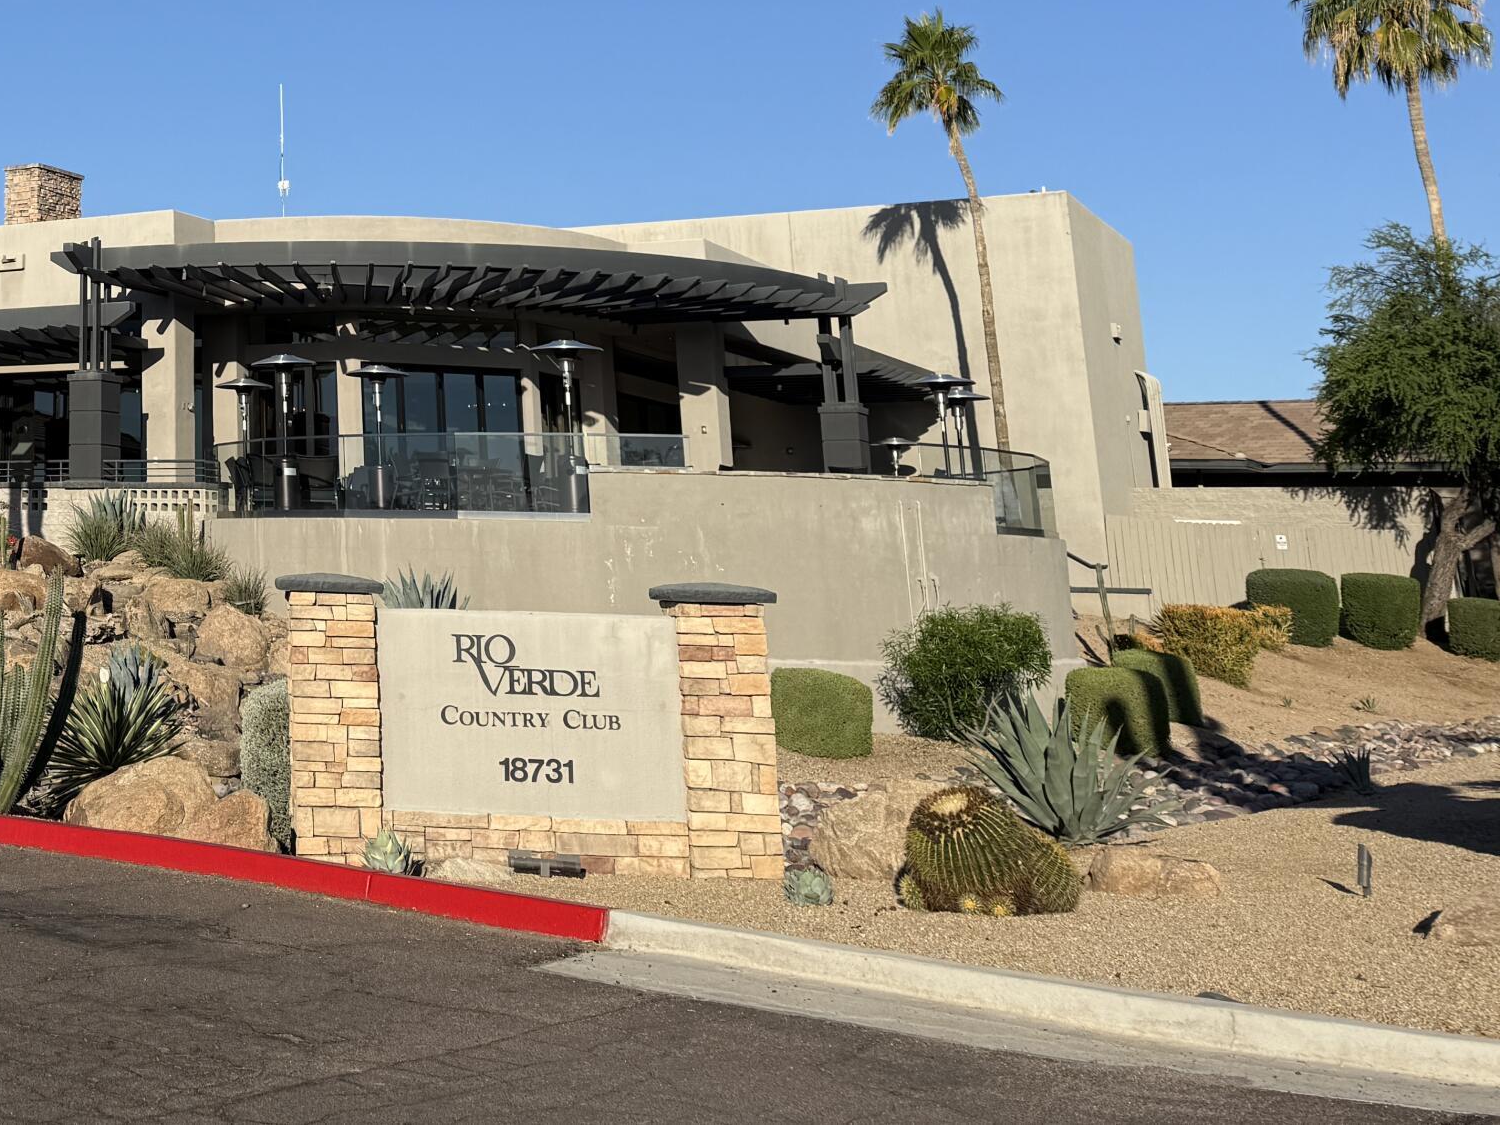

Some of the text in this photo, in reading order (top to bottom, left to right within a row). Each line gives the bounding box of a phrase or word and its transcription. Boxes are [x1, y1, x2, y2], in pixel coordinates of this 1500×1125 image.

[451, 634, 516, 665] RIO
[474, 665, 600, 697] VERDE
[498, 757, 575, 784] 18731
